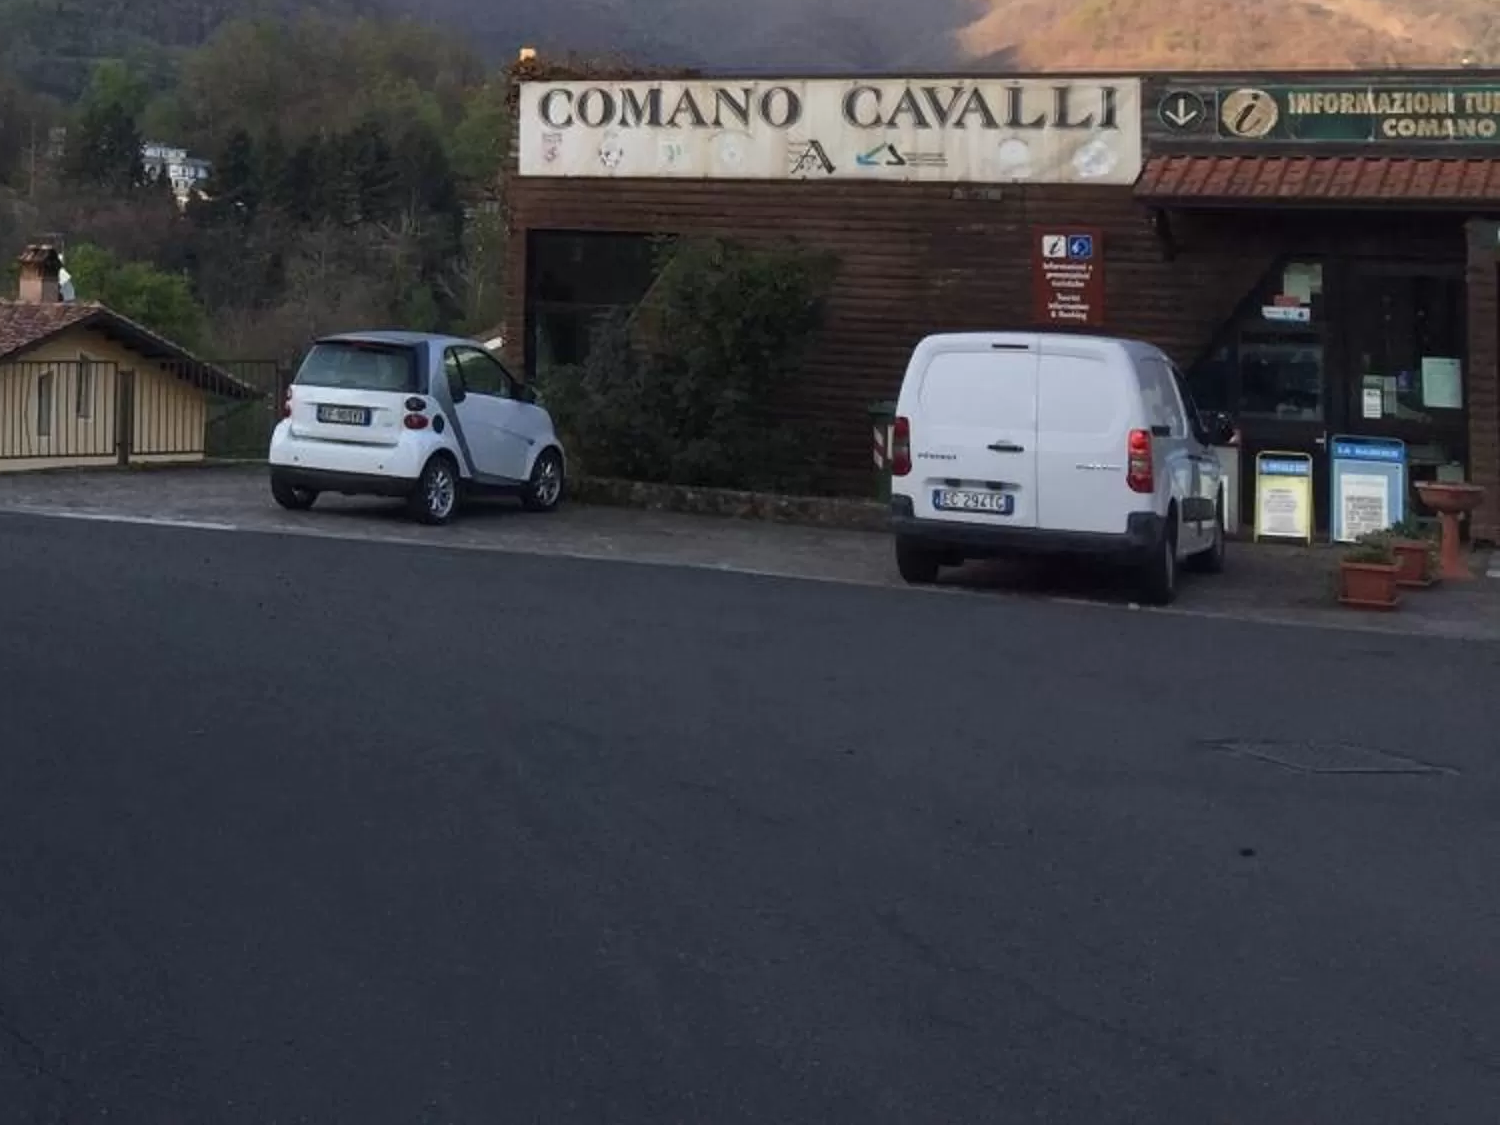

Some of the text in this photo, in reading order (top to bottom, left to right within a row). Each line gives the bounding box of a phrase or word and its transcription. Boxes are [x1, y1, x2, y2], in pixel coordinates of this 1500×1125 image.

[537, 84, 1120, 131] COMANO CAVALLI
[1288, 90, 1455, 114] INFORMAZIONI
[1382, 118, 1497, 138] COMANO
